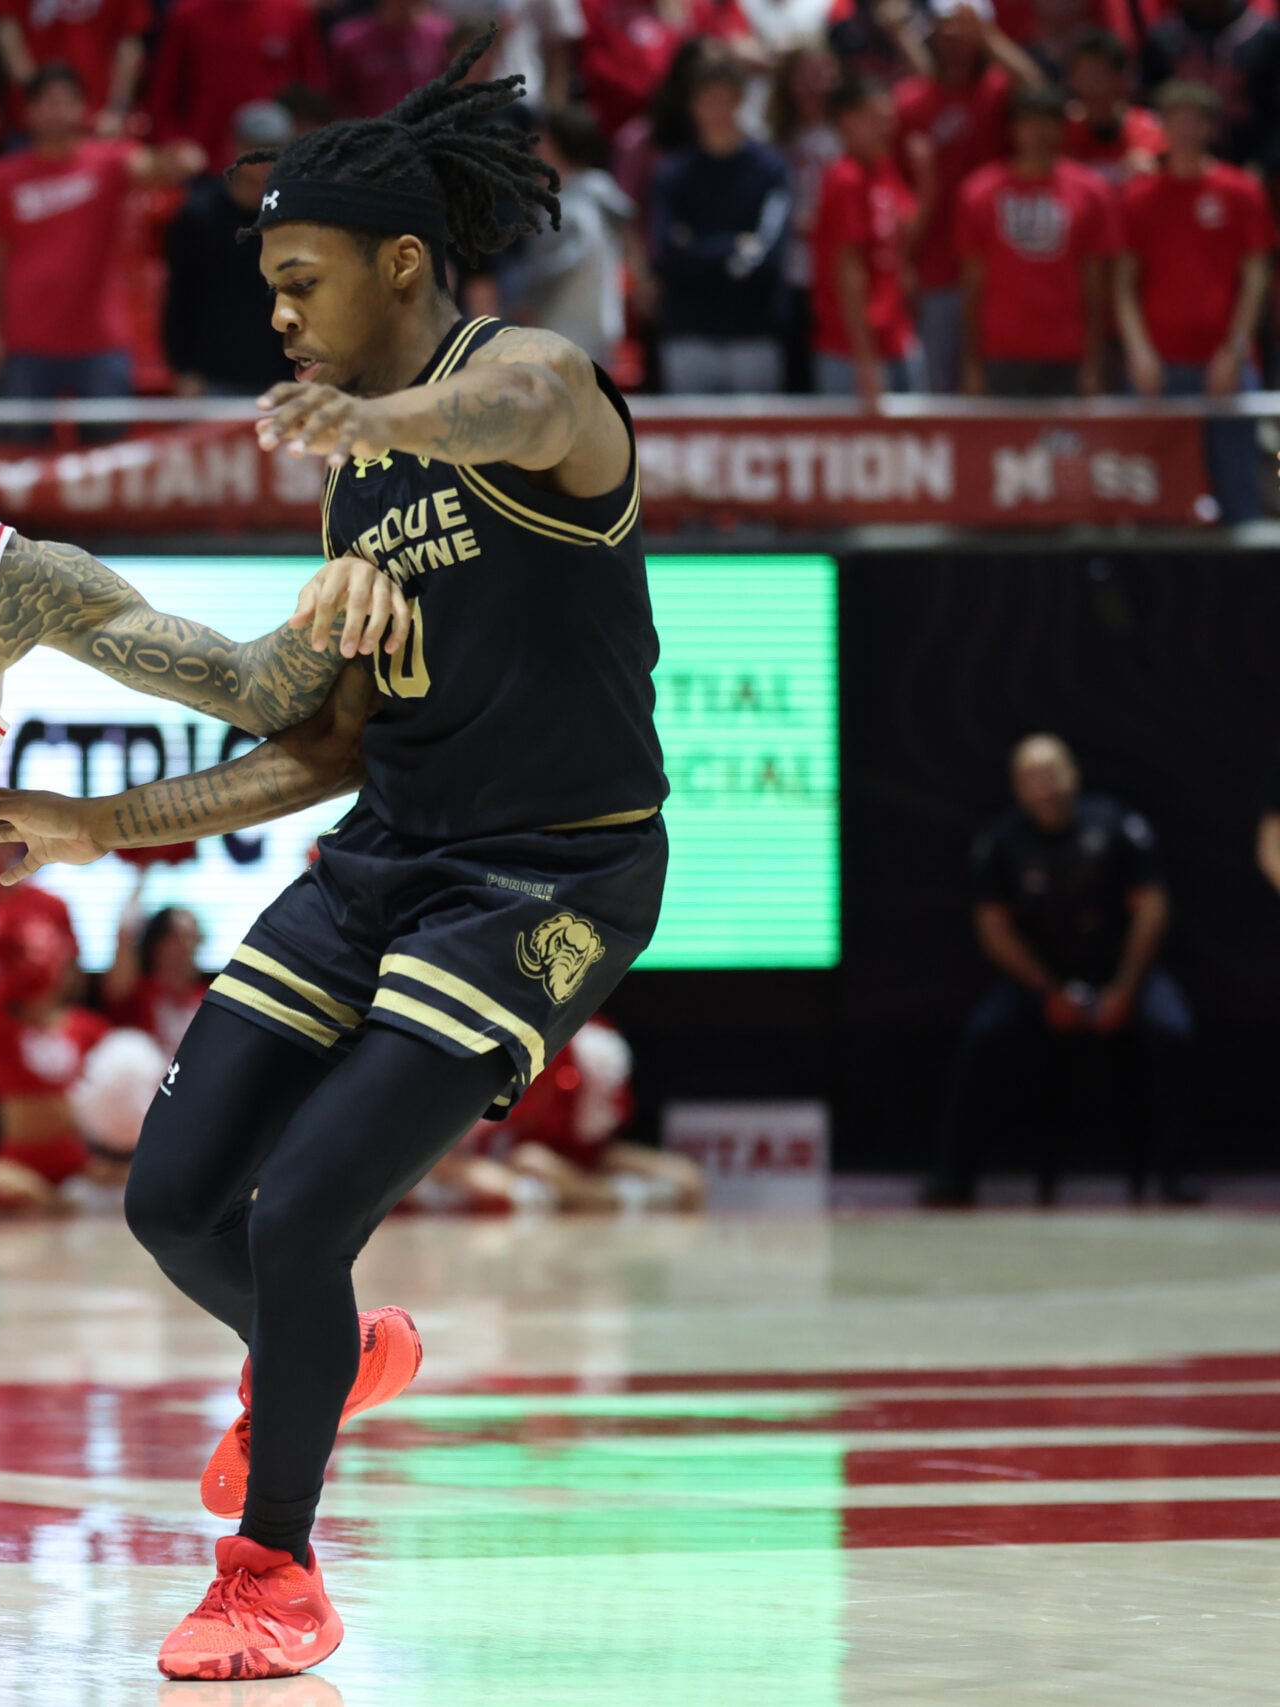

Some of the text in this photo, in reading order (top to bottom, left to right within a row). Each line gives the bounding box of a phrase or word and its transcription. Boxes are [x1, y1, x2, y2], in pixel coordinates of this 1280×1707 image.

[57, 440, 258, 511] UTAH
[639, 432, 956, 504] SECTION
[353, 487, 467, 566] RDUE
[91, 635, 241, 693] 2003
[486, 872, 556, 896] PURDUE
